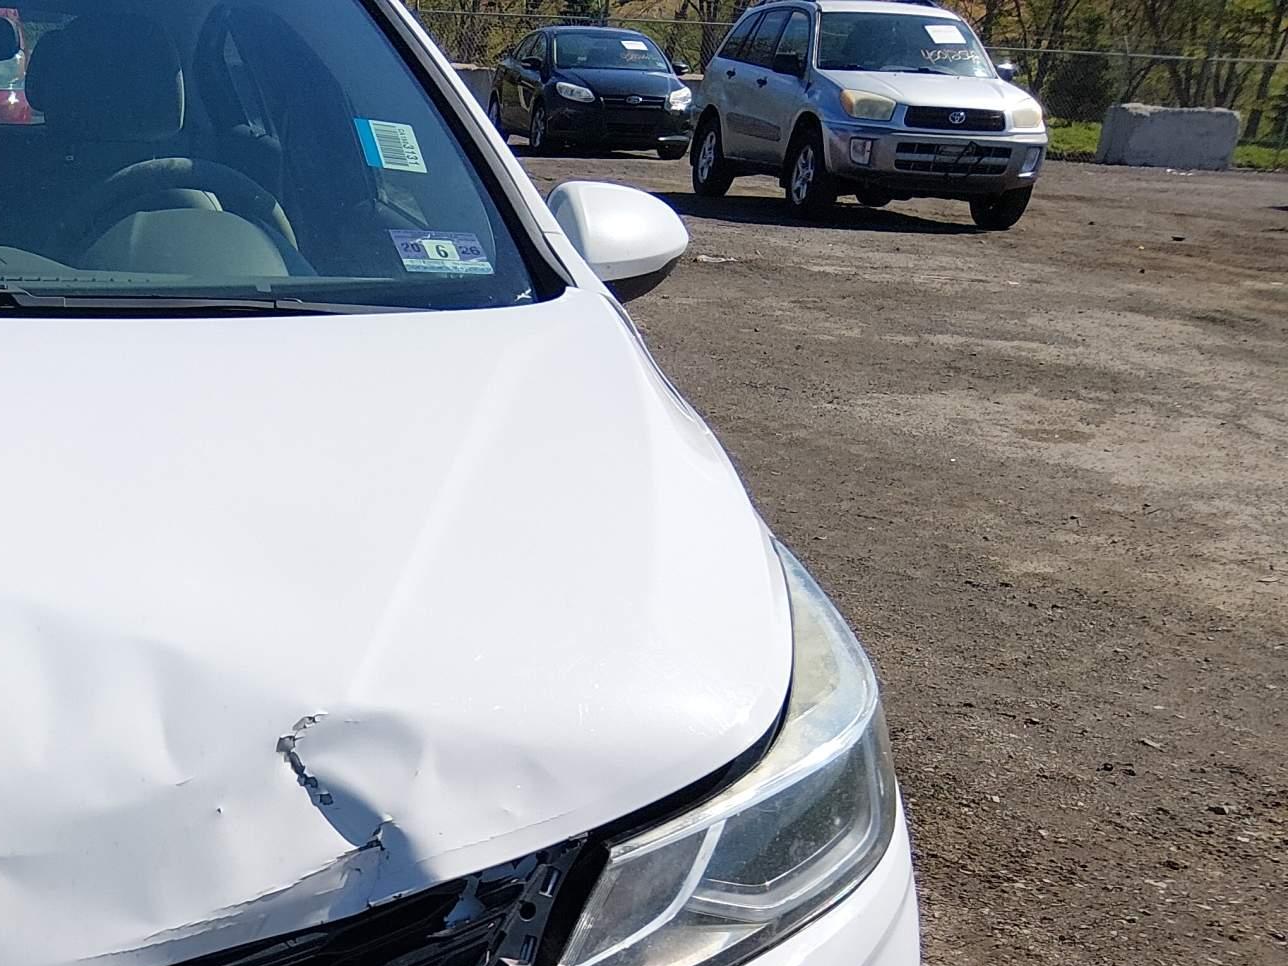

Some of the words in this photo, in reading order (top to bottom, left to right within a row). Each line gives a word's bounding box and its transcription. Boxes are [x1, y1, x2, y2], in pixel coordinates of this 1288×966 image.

[400, 242, 421, 253] 20
[435, 244, 449, 258] 6
[458, 246, 481, 256] 26
